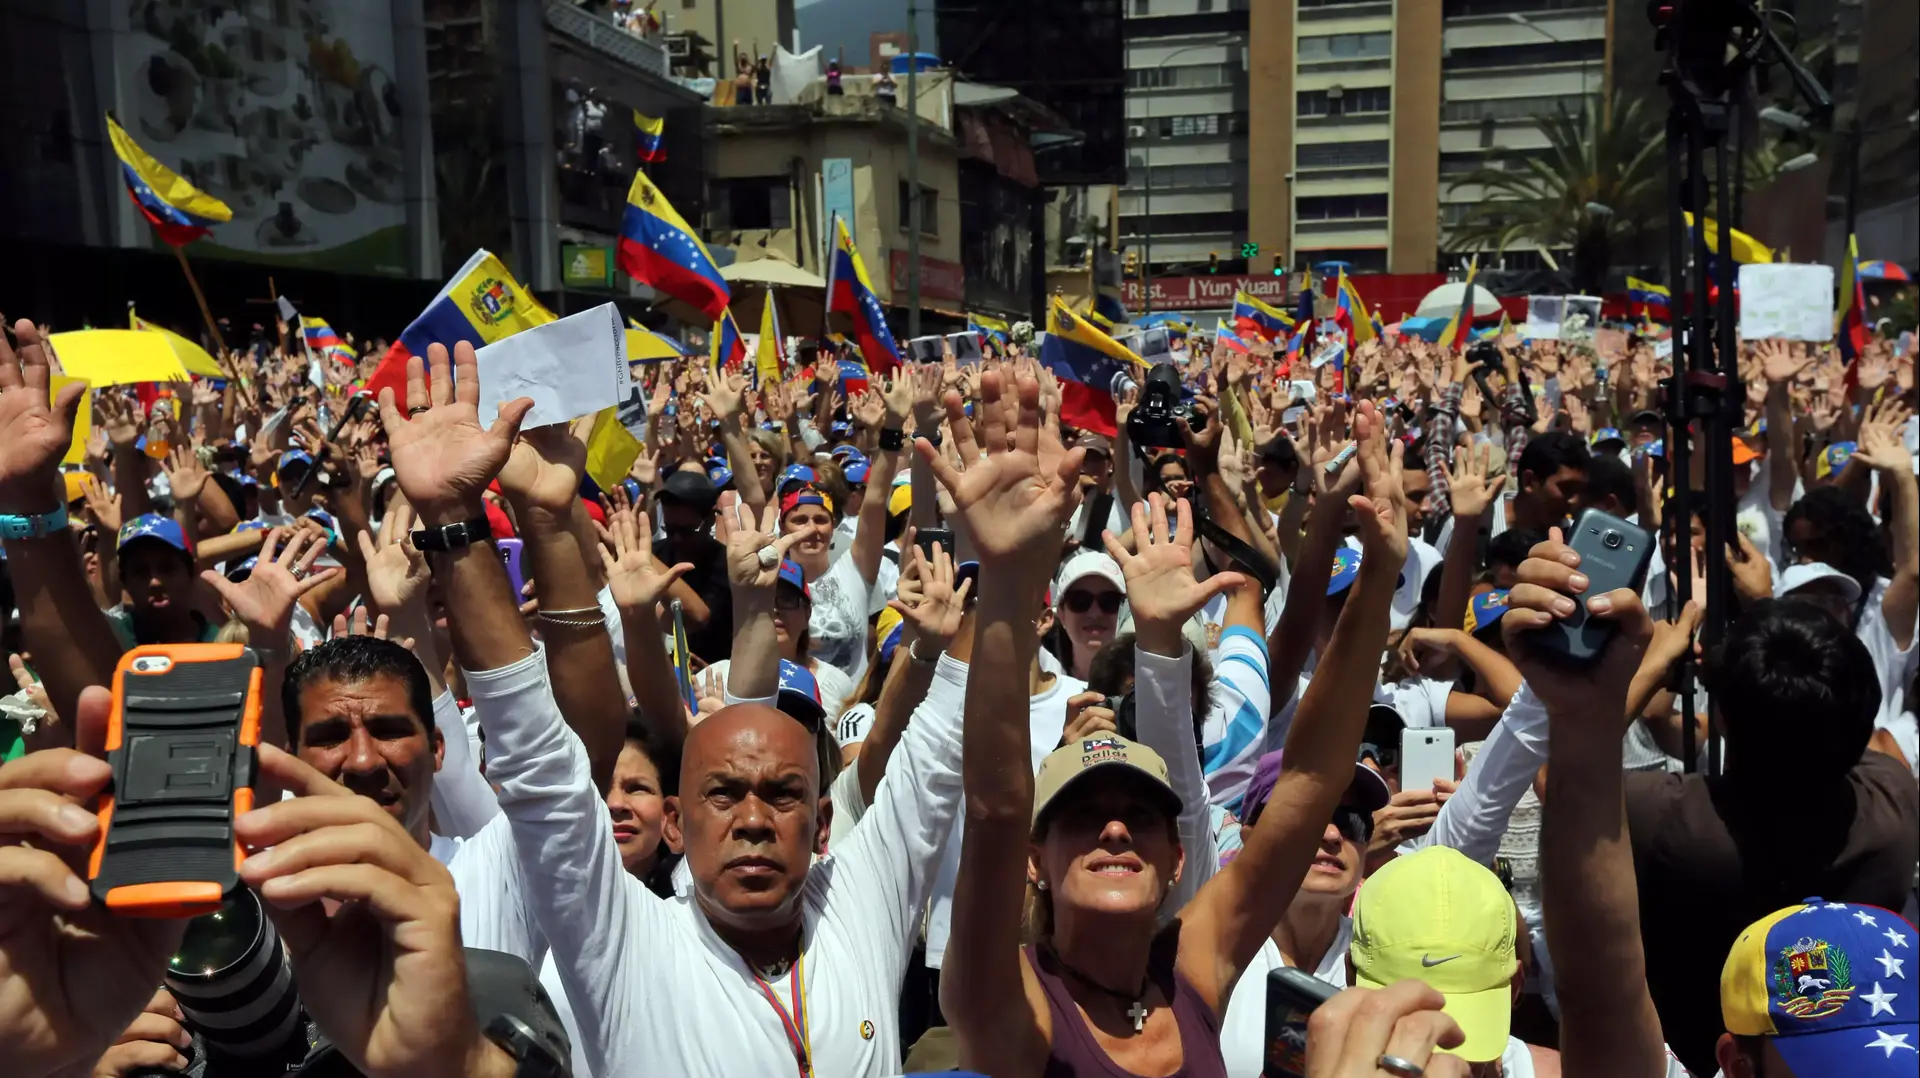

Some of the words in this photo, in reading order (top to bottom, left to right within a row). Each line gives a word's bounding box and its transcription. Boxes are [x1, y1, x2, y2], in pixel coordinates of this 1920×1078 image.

[1241, 243, 1258, 257] 22
[1198, 279, 1232, 297] Yun
[1236, 278, 1280, 294] Yuan
[1082, 749, 1127, 763] Dallas
